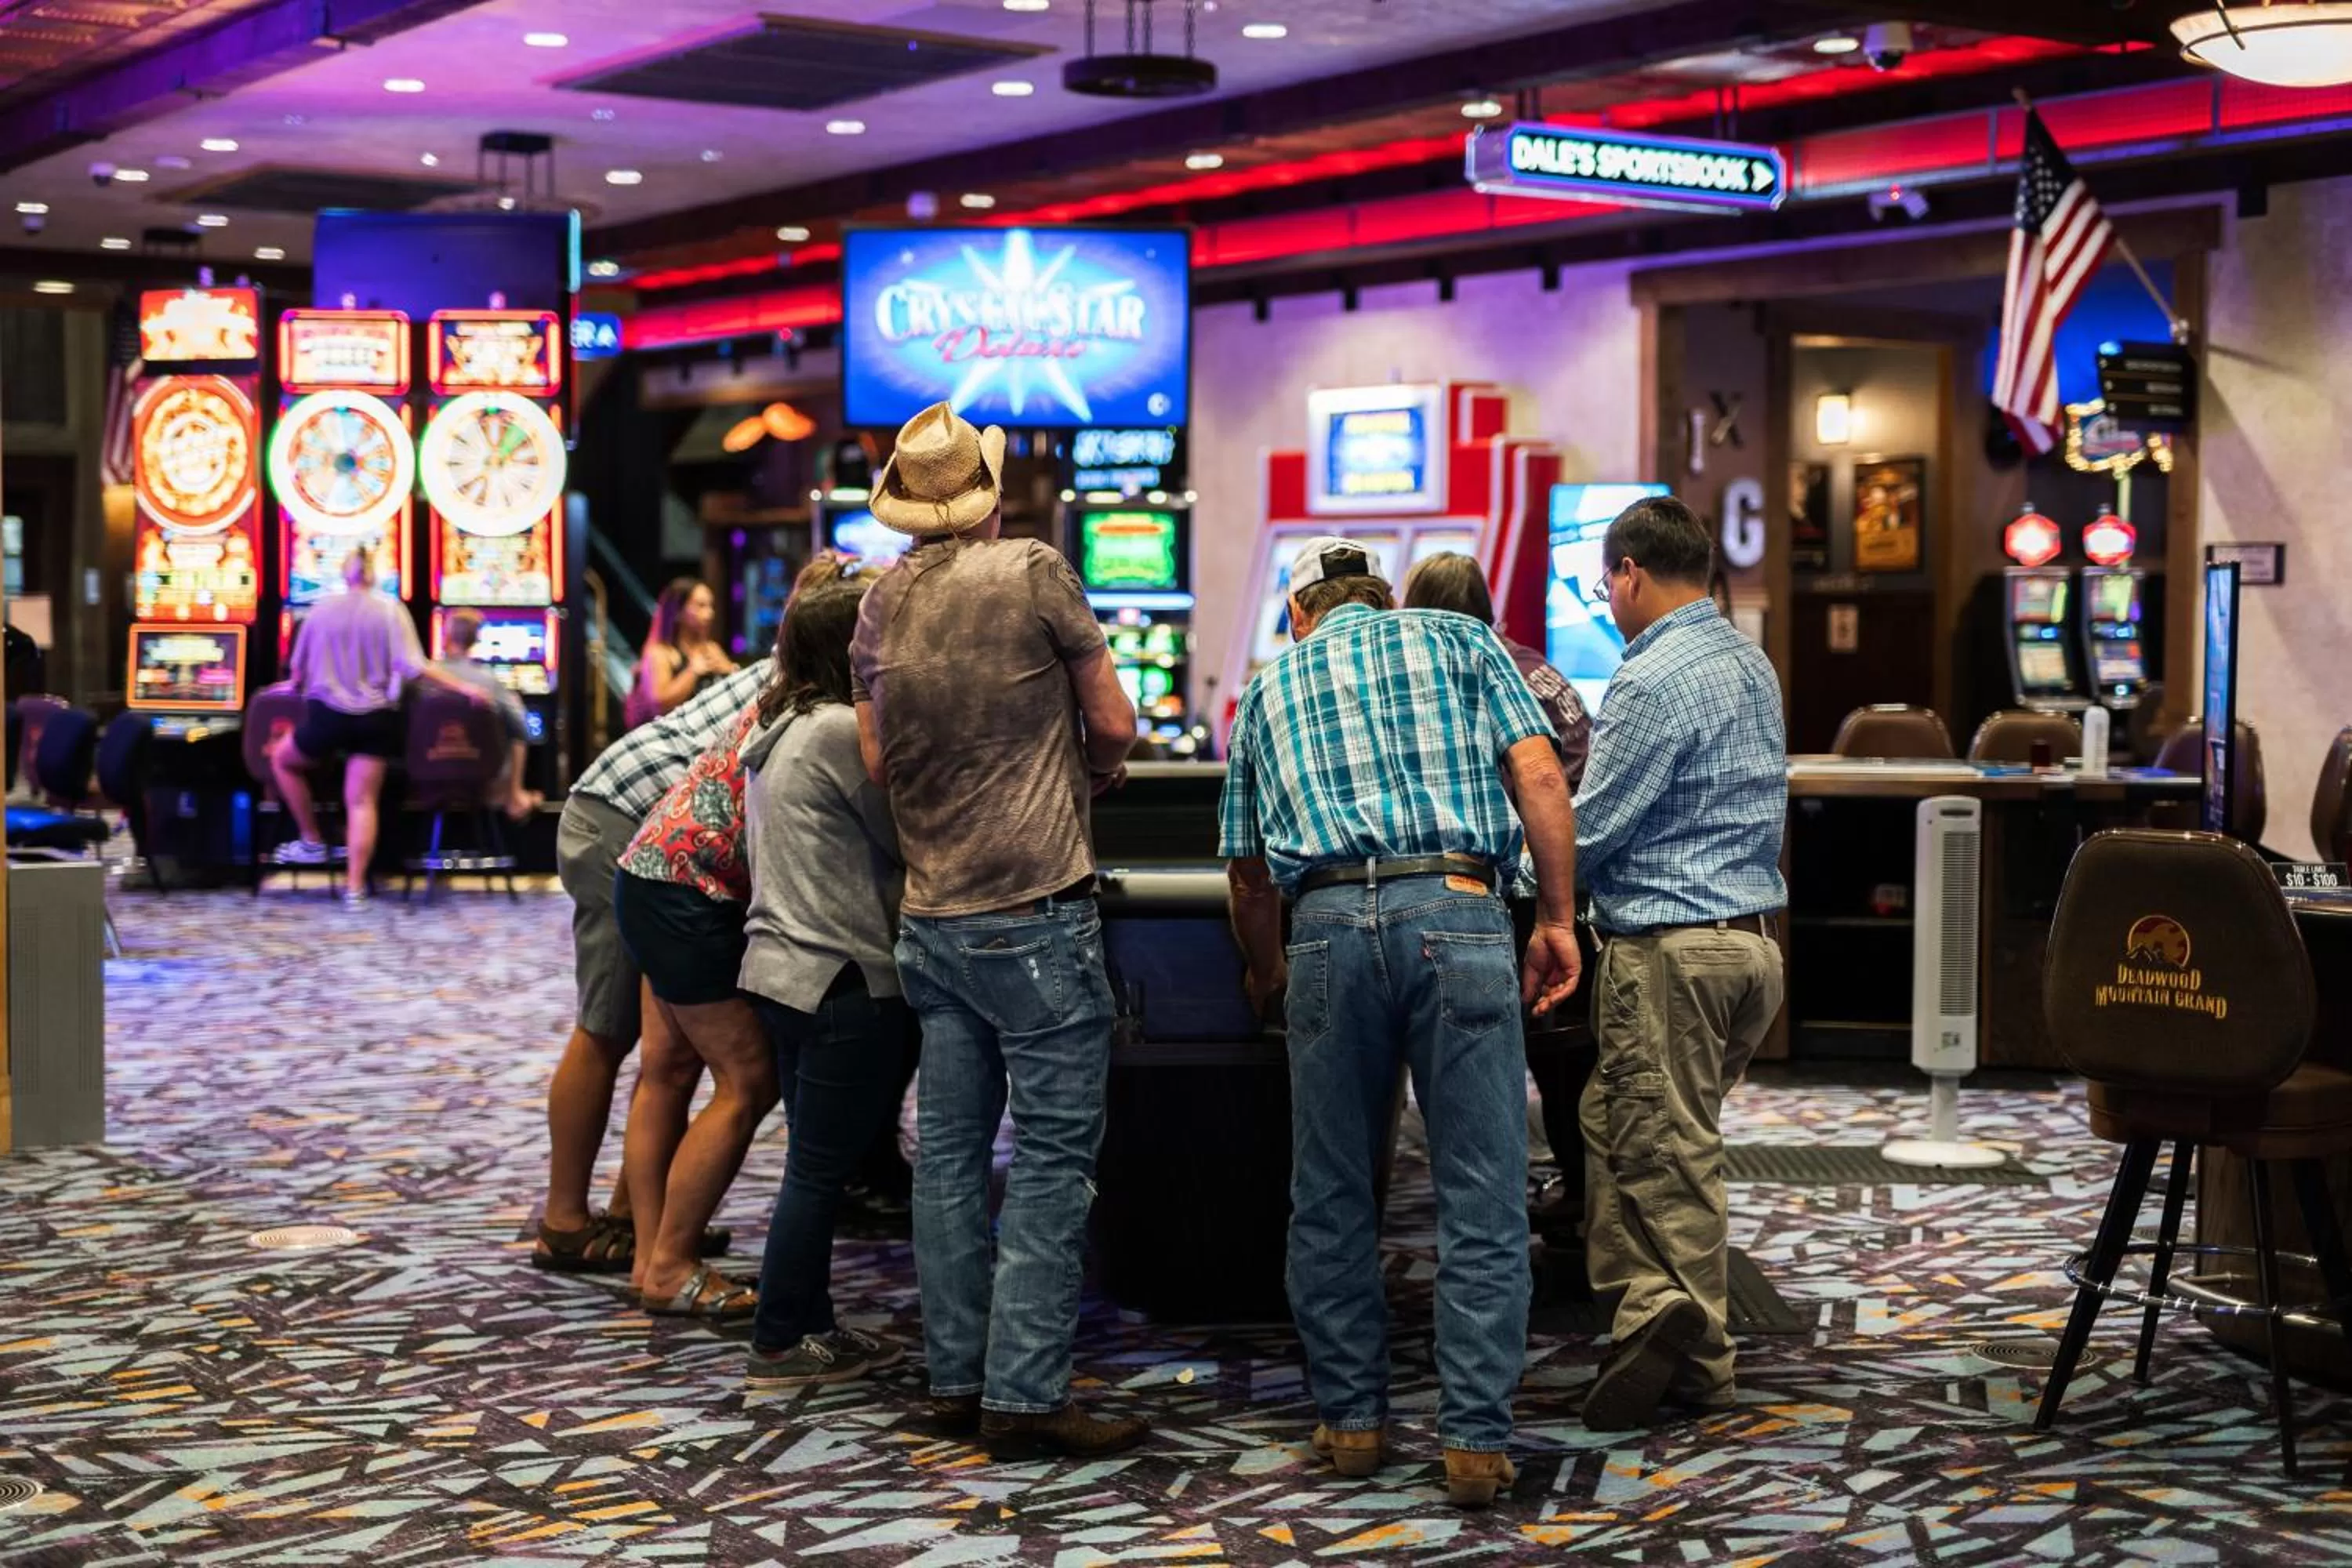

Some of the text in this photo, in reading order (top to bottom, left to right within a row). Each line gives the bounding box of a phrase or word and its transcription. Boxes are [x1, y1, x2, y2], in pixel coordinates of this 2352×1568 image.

[1511, 136, 1749, 191] DALE'S SPORTSBOOK
[1046, 282, 1146, 339] STAR
[2285, 872, 2305, 887] $10
[2313, 872, 2338, 887] $100
[2118, 964, 2201, 991] DEADWOOD
[2095, 985, 2228, 1019] MOUNTAIN GRAND
